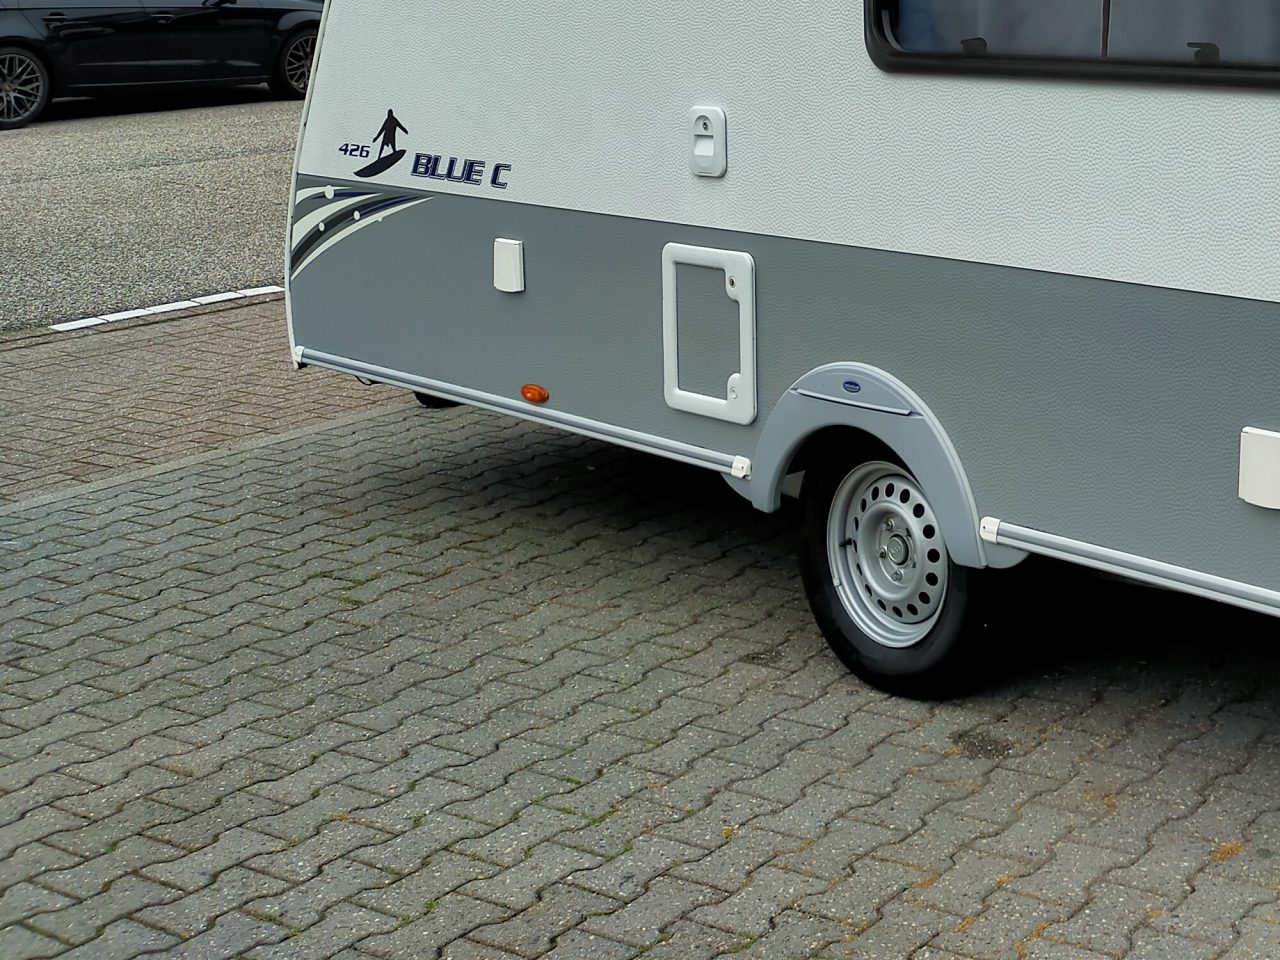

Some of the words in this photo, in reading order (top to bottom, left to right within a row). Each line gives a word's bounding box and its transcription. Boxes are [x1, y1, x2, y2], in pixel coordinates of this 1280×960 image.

[338, 142, 371, 158] 426
[410, 152, 486, 186] BLUE
[490, 162, 512, 189] C
